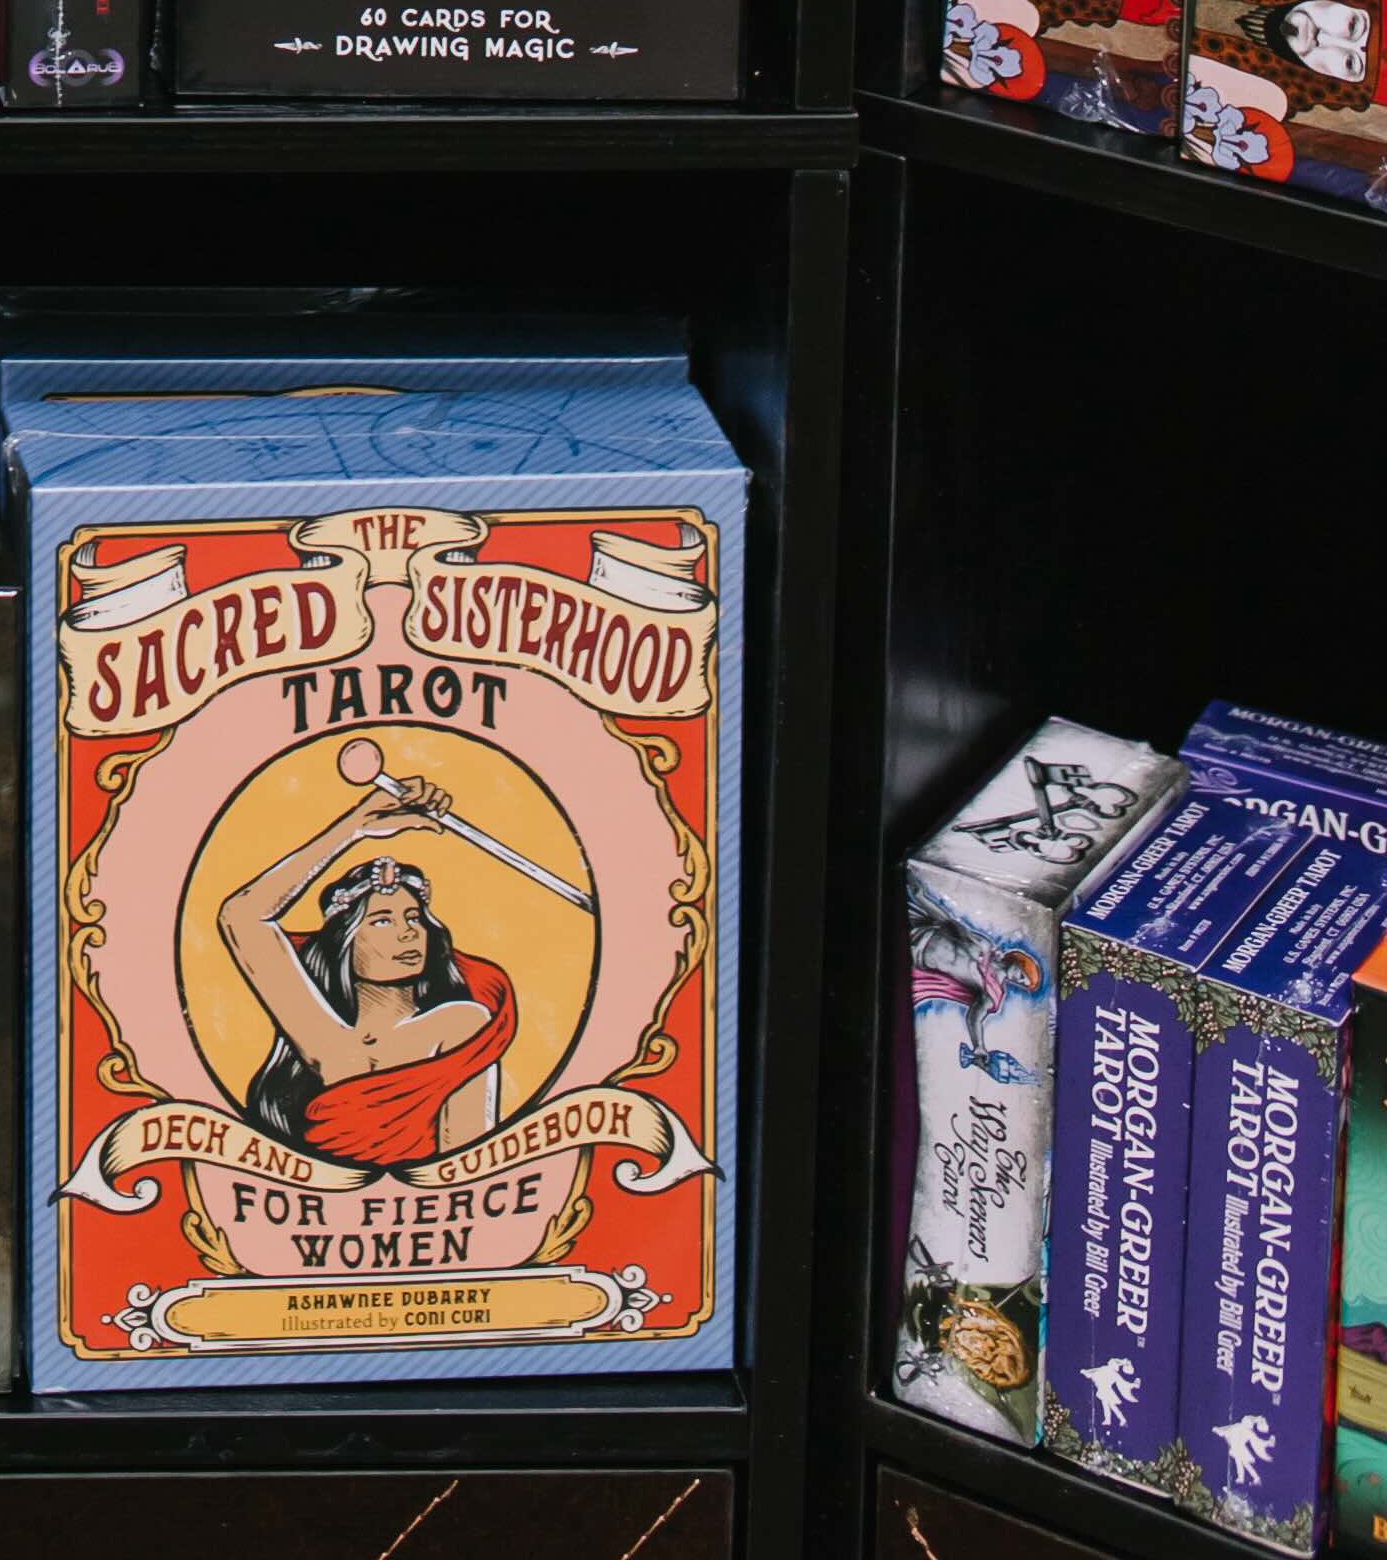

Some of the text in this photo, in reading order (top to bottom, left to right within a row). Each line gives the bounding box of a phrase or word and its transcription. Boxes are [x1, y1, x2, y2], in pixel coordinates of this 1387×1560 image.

[361, 9, 558, 35] 60 CARDS FOR
[335, 35, 576, 62] DRAWING MAGIC
[351, 514, 429, 550] THE
[87, 575, 693, 722] SACRED SISTERHOOD
[283, 664, 508, 733] TAROT
[1091, 1006, 1128, 1139] TAROT
[234, 1174, 542, 1227] FOR FIERCE
[293, 1228, 471, 1270] WOMEN
[287, 1289, 491, 1314] ASHAWNEE DUBARRY
